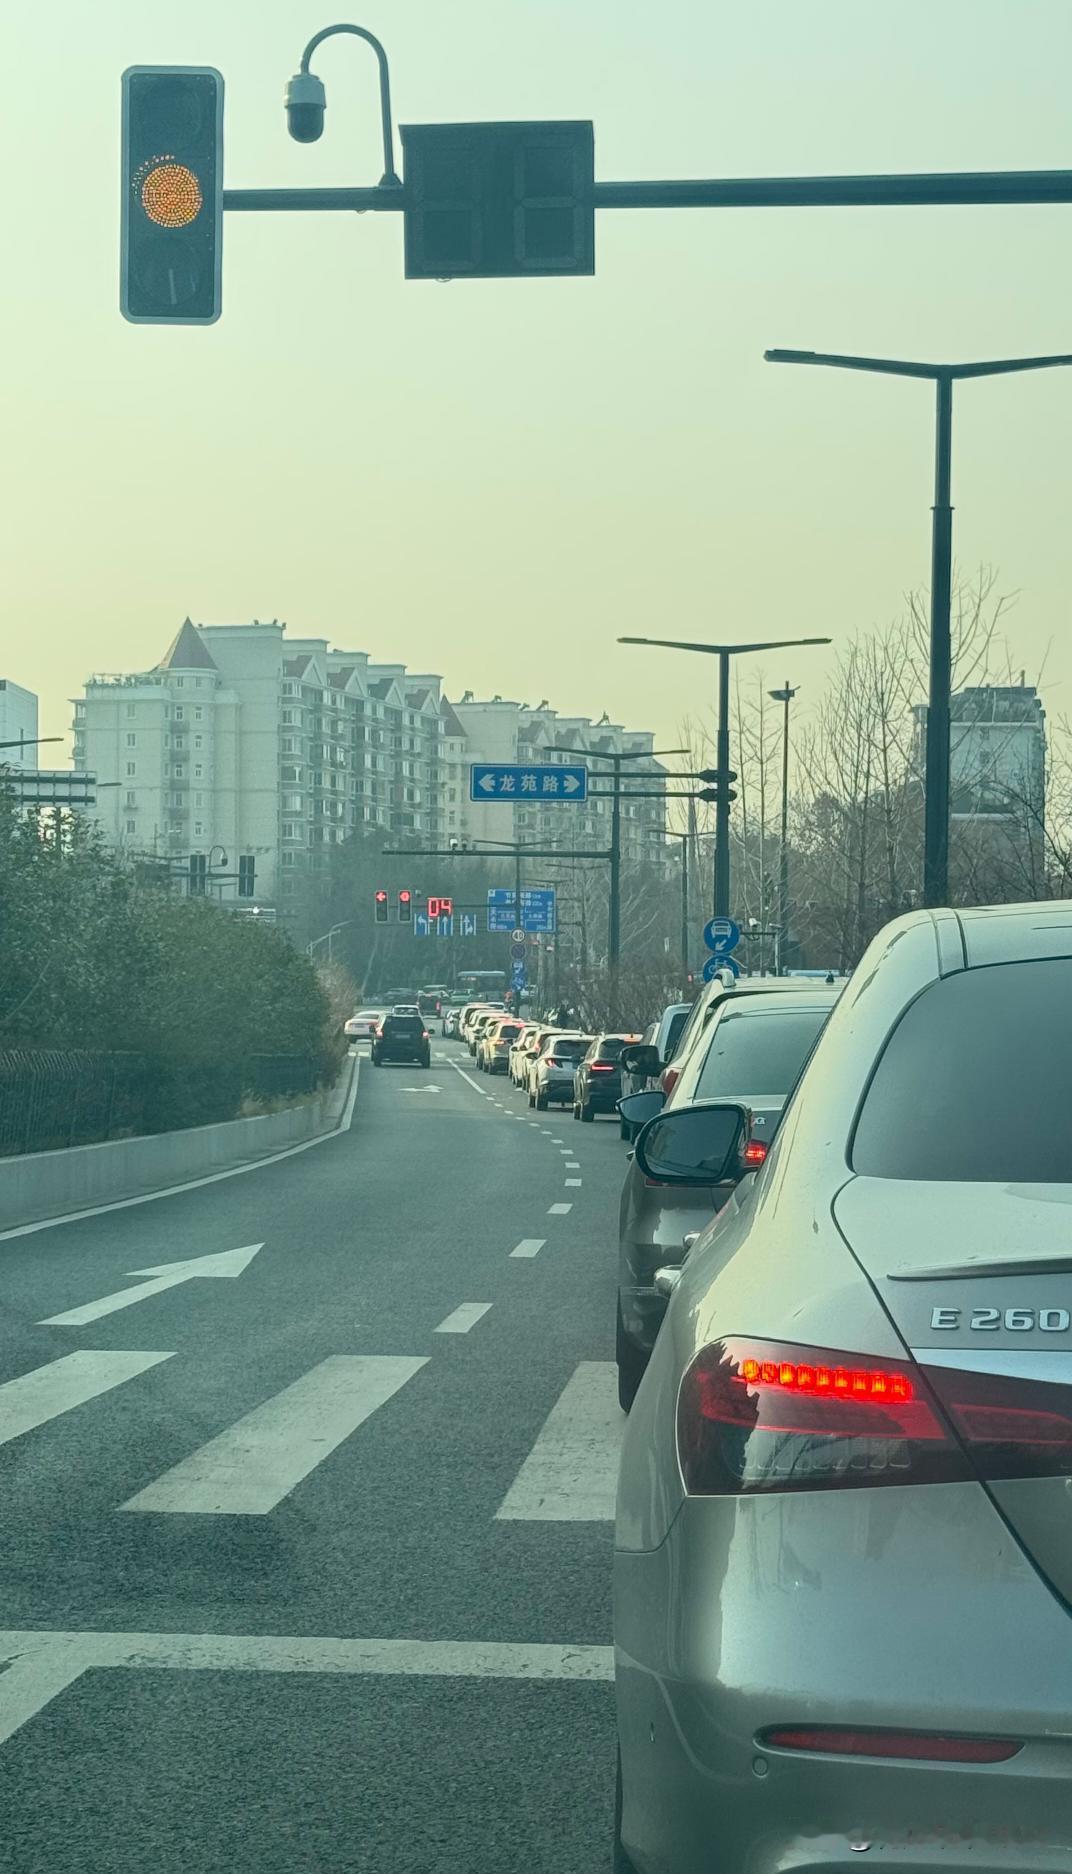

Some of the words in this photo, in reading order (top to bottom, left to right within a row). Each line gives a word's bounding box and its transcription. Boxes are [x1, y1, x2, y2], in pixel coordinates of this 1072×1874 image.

[499, 774, 559, 793] 龙苑路
[428, 897, 452, 917] 04
[930, 1307, 960, 1330] E
[970, 1307, 1071, 1333] 260
